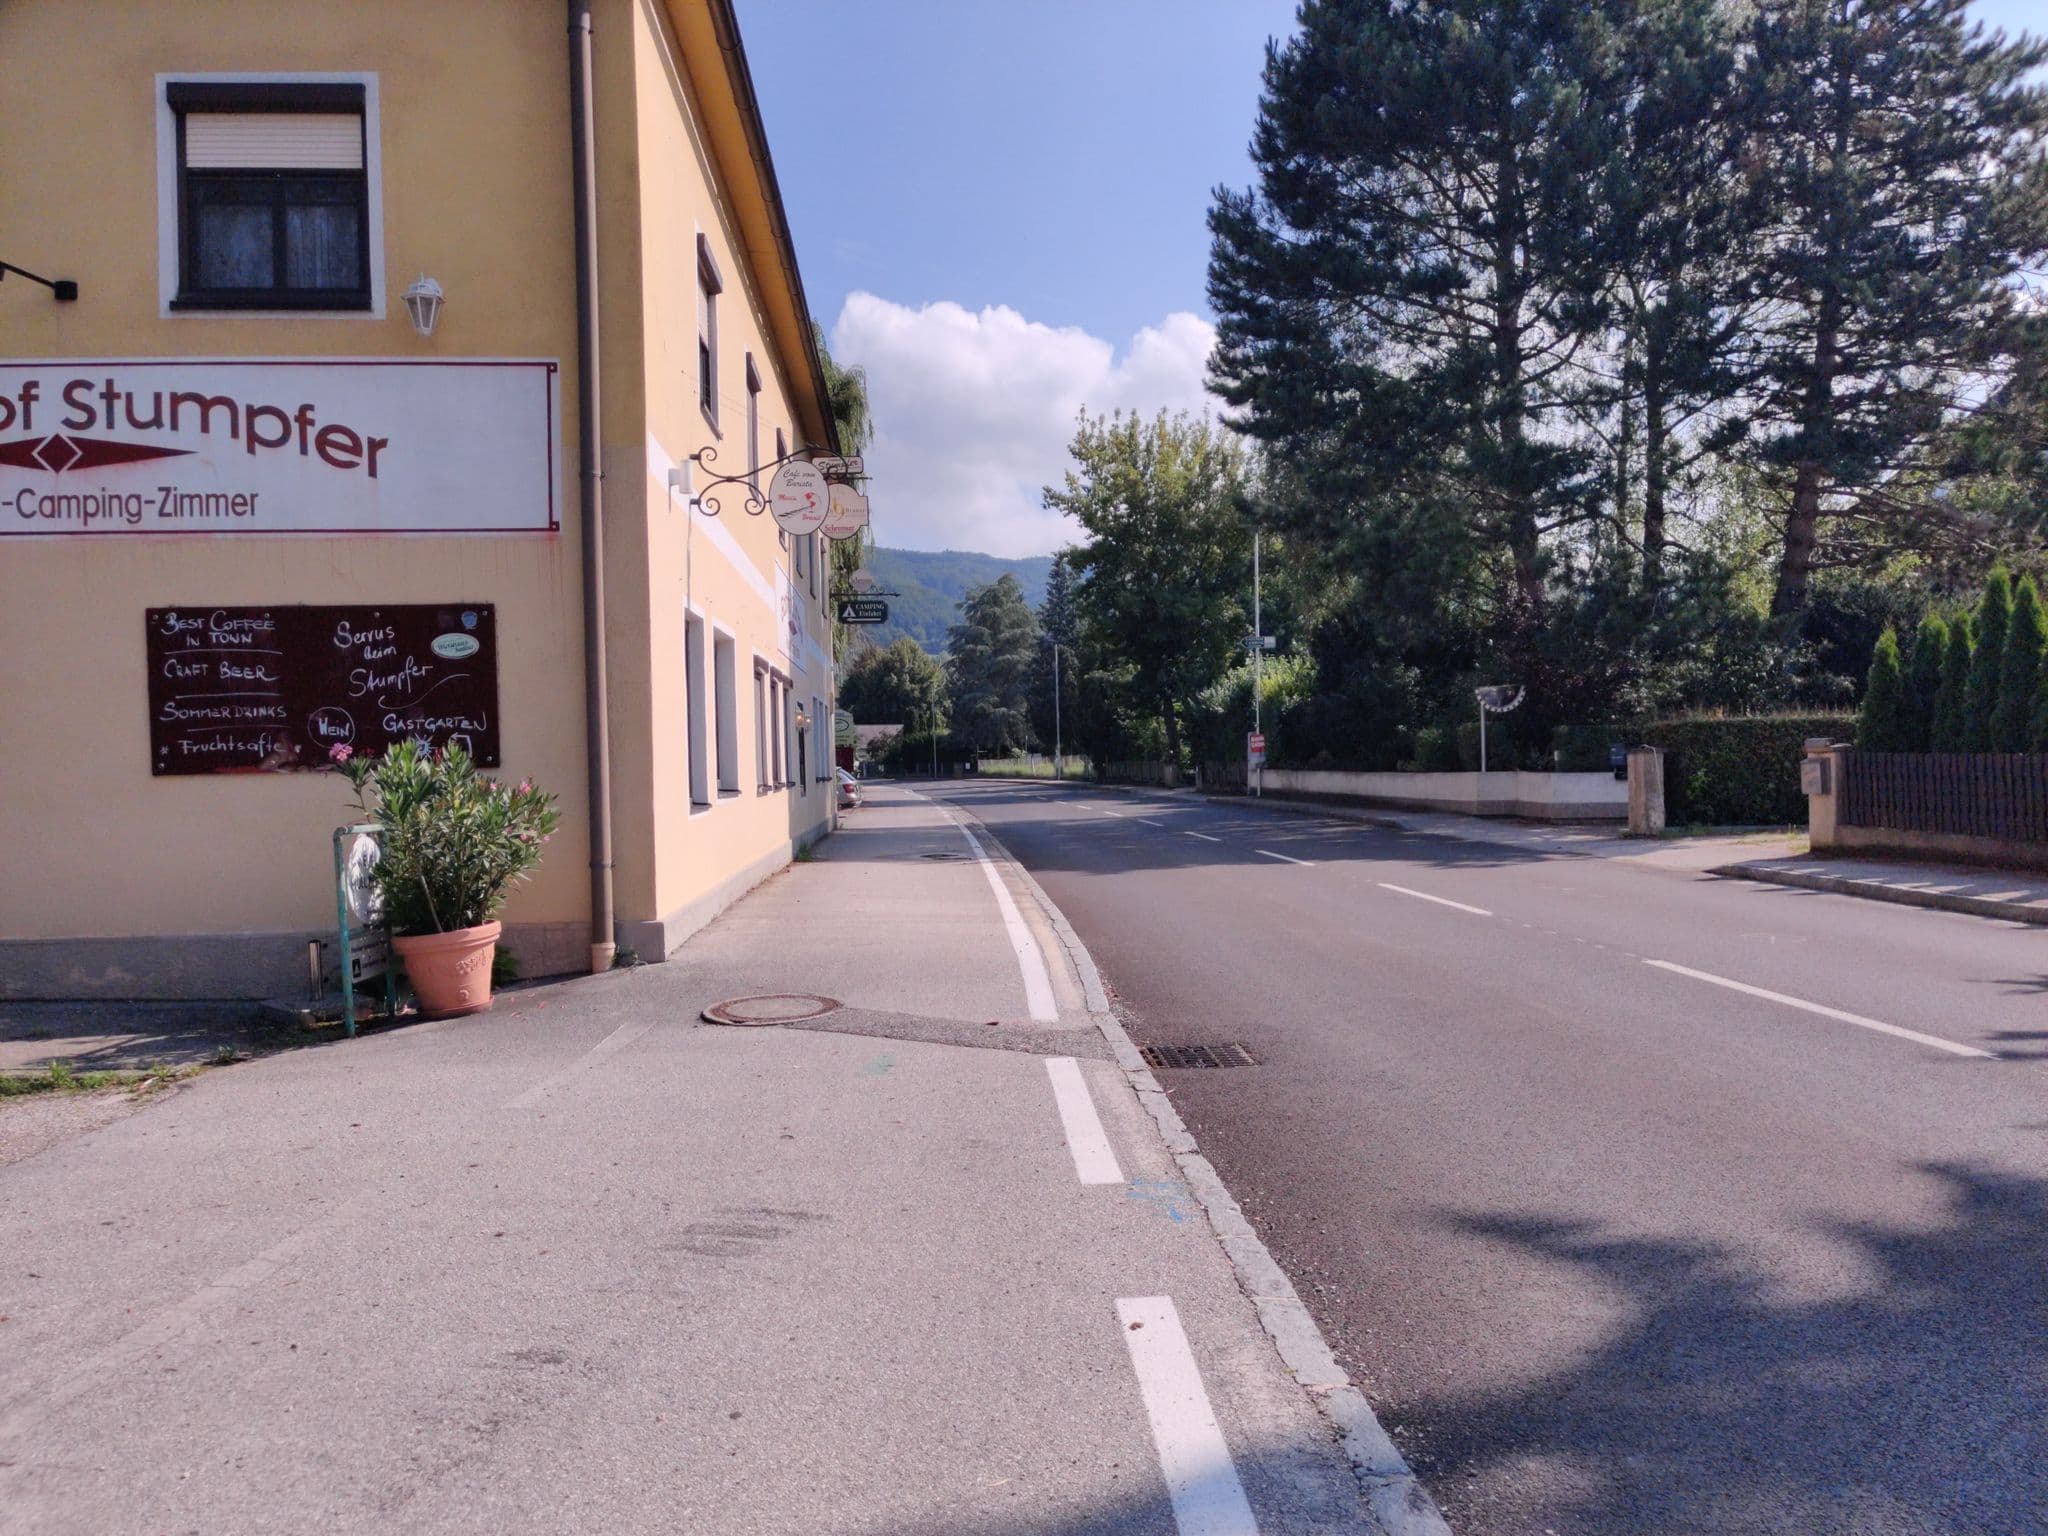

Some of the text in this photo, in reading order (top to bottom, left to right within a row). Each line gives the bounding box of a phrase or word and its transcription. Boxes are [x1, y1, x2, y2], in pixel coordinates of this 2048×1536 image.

[61, 378, 389, 479] Stumpfer
[161, 611, 276, 635] BEST COFFEE
[333, 620, 395, 649] Servus
[187, 631, 253, 647] IN TOWN
[163, 658, 281, 682] CRAFT BEER
[349, 655, 434, 697] Stumpfer
[318, 716, 351, 737] WEIN
